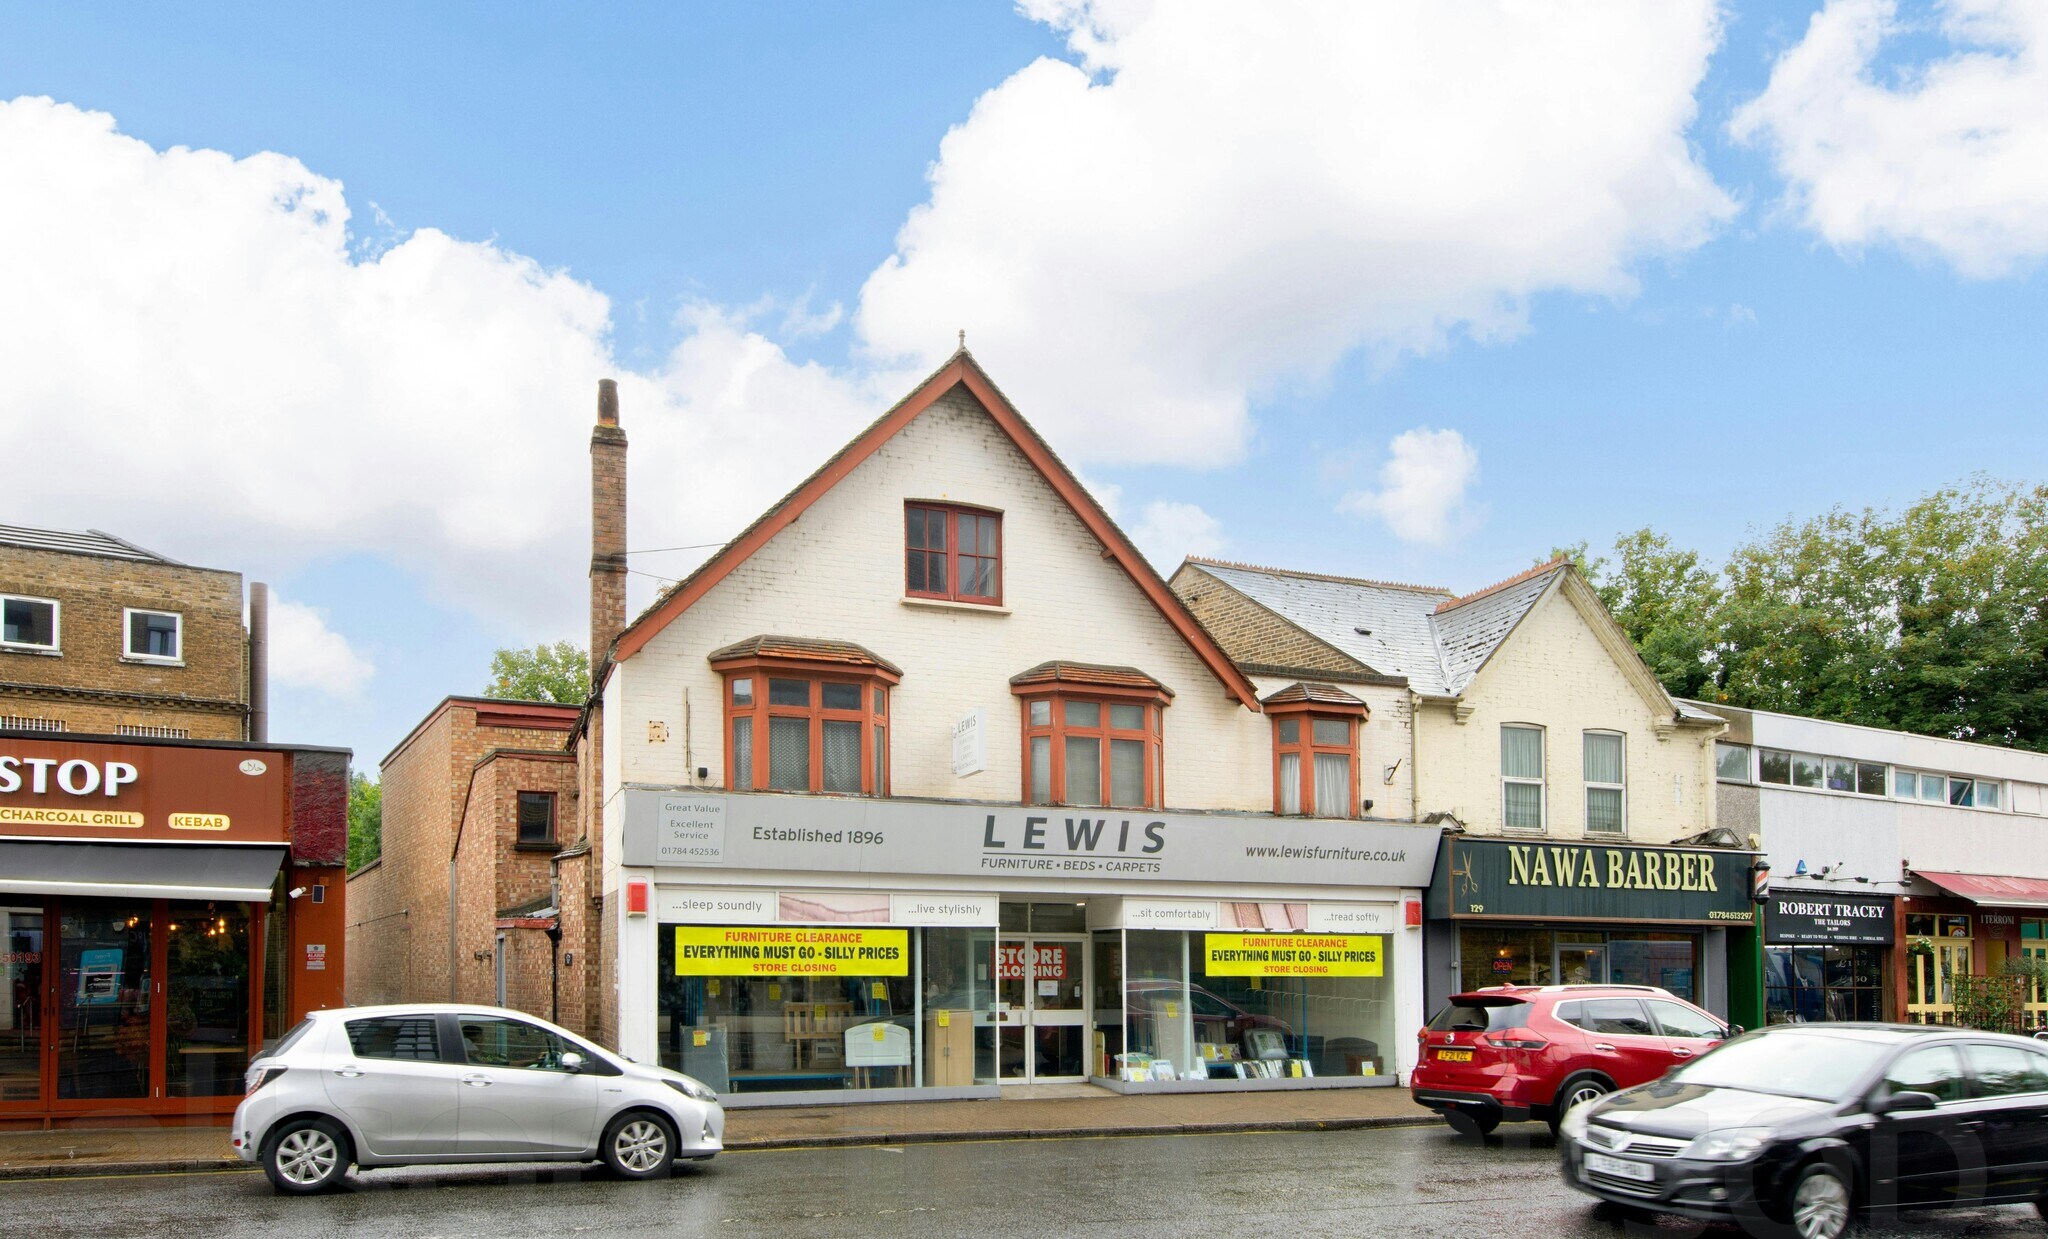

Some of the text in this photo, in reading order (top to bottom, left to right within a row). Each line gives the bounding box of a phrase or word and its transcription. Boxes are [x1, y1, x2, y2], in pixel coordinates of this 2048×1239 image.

[957, 714, 977, 734] LEWIS
[0, 756, 138, 796] STOP
[665, 803, 721, 814] Great Value
[0, 809, 136, 825] CHARCOAL GRILL
[174, 816, 223, 828] KEBAB
[670, 819, 714, 829] Excellent
[674, 830, 709, 840] Service
[753, 826, 884, 845] Established 1896
[983, 815, 1166, 854] LEWIS
[661, 847, 720, 857] 01784 452536
[1245, 844, 1406, 863] www.lewisfurniture.co.uk
[981, 858, 1161, 873] FURNITURE BEDS CARPETS
[1509, 845, 1718, 893] NAWA BARBER
[672, 899, 762, 913] ...sleep soundly
[908, 903, 982, 917] ...live stylishly
[1470, 904, 1484, 913] 129
[1779, 902, 1885, 918] ROBERT TRACEY
[1132, 909, 1211, 921] ...sit comfortably
[1324, 912, 1380, 923] ...tread softly
[1709, 911, 1753, 920] 01784613297
[1984, 913, 2015, 925] TERRONI
[725, 931, 863, 943] FURNITURE CLEARANCE
[1242, 938, 1348, 948] FURNITURE CLEARANCE
[684, 945, 760, 960] EVERYTHING
[763, 946, 796, 960] MUST
[798, 946, 816, 960] GO
[824, 946, 855, 960] SILLY
[858, 947, 900, 960] PRICES
[1211, 949, 1269, 962] EVERYTHING
[1271, 950, 1296, 962] MUST
[1298, 950, 1312, 962] GO
[1318, 951, 1342, 962] SILLY
[1344, 951, 1376, 963] PRICES
[753, 963, 838, 973] STORE CLOSING
[1263, 965, 1329, 974] STORE CLOSING
